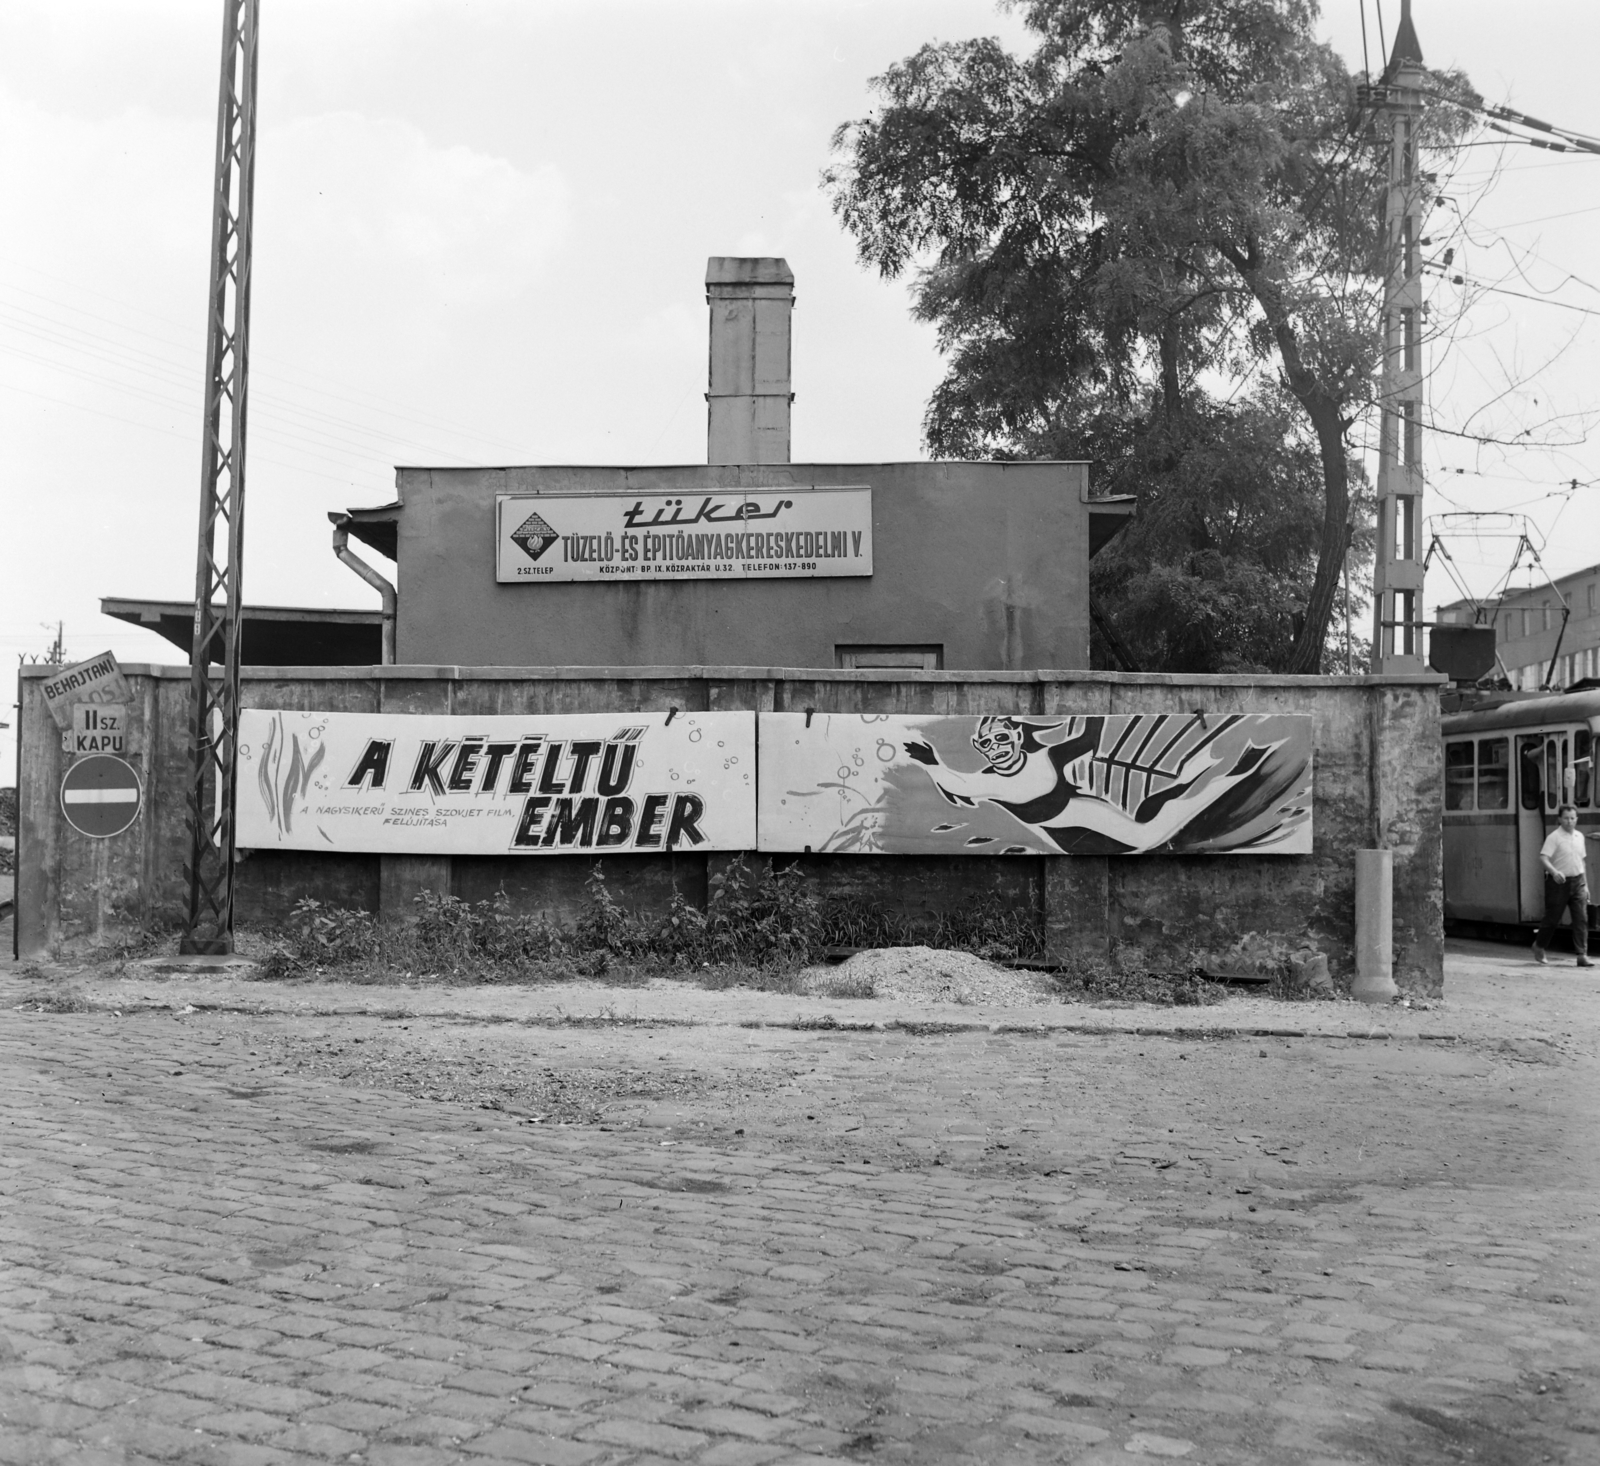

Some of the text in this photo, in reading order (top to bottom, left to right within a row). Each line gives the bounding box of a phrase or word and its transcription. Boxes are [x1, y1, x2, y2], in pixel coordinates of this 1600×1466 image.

[45, 659, 114, 700] BEHAJTANI
[77, 735, 123, 752] KAPU
[345, 740, 394, 790] A
[300, 806, 309, 814] A
[391, 808, 429, 816] SZINES
[436, 808, 483, 818] SZOVJET
[513, 795, 709, 849] EMBER
